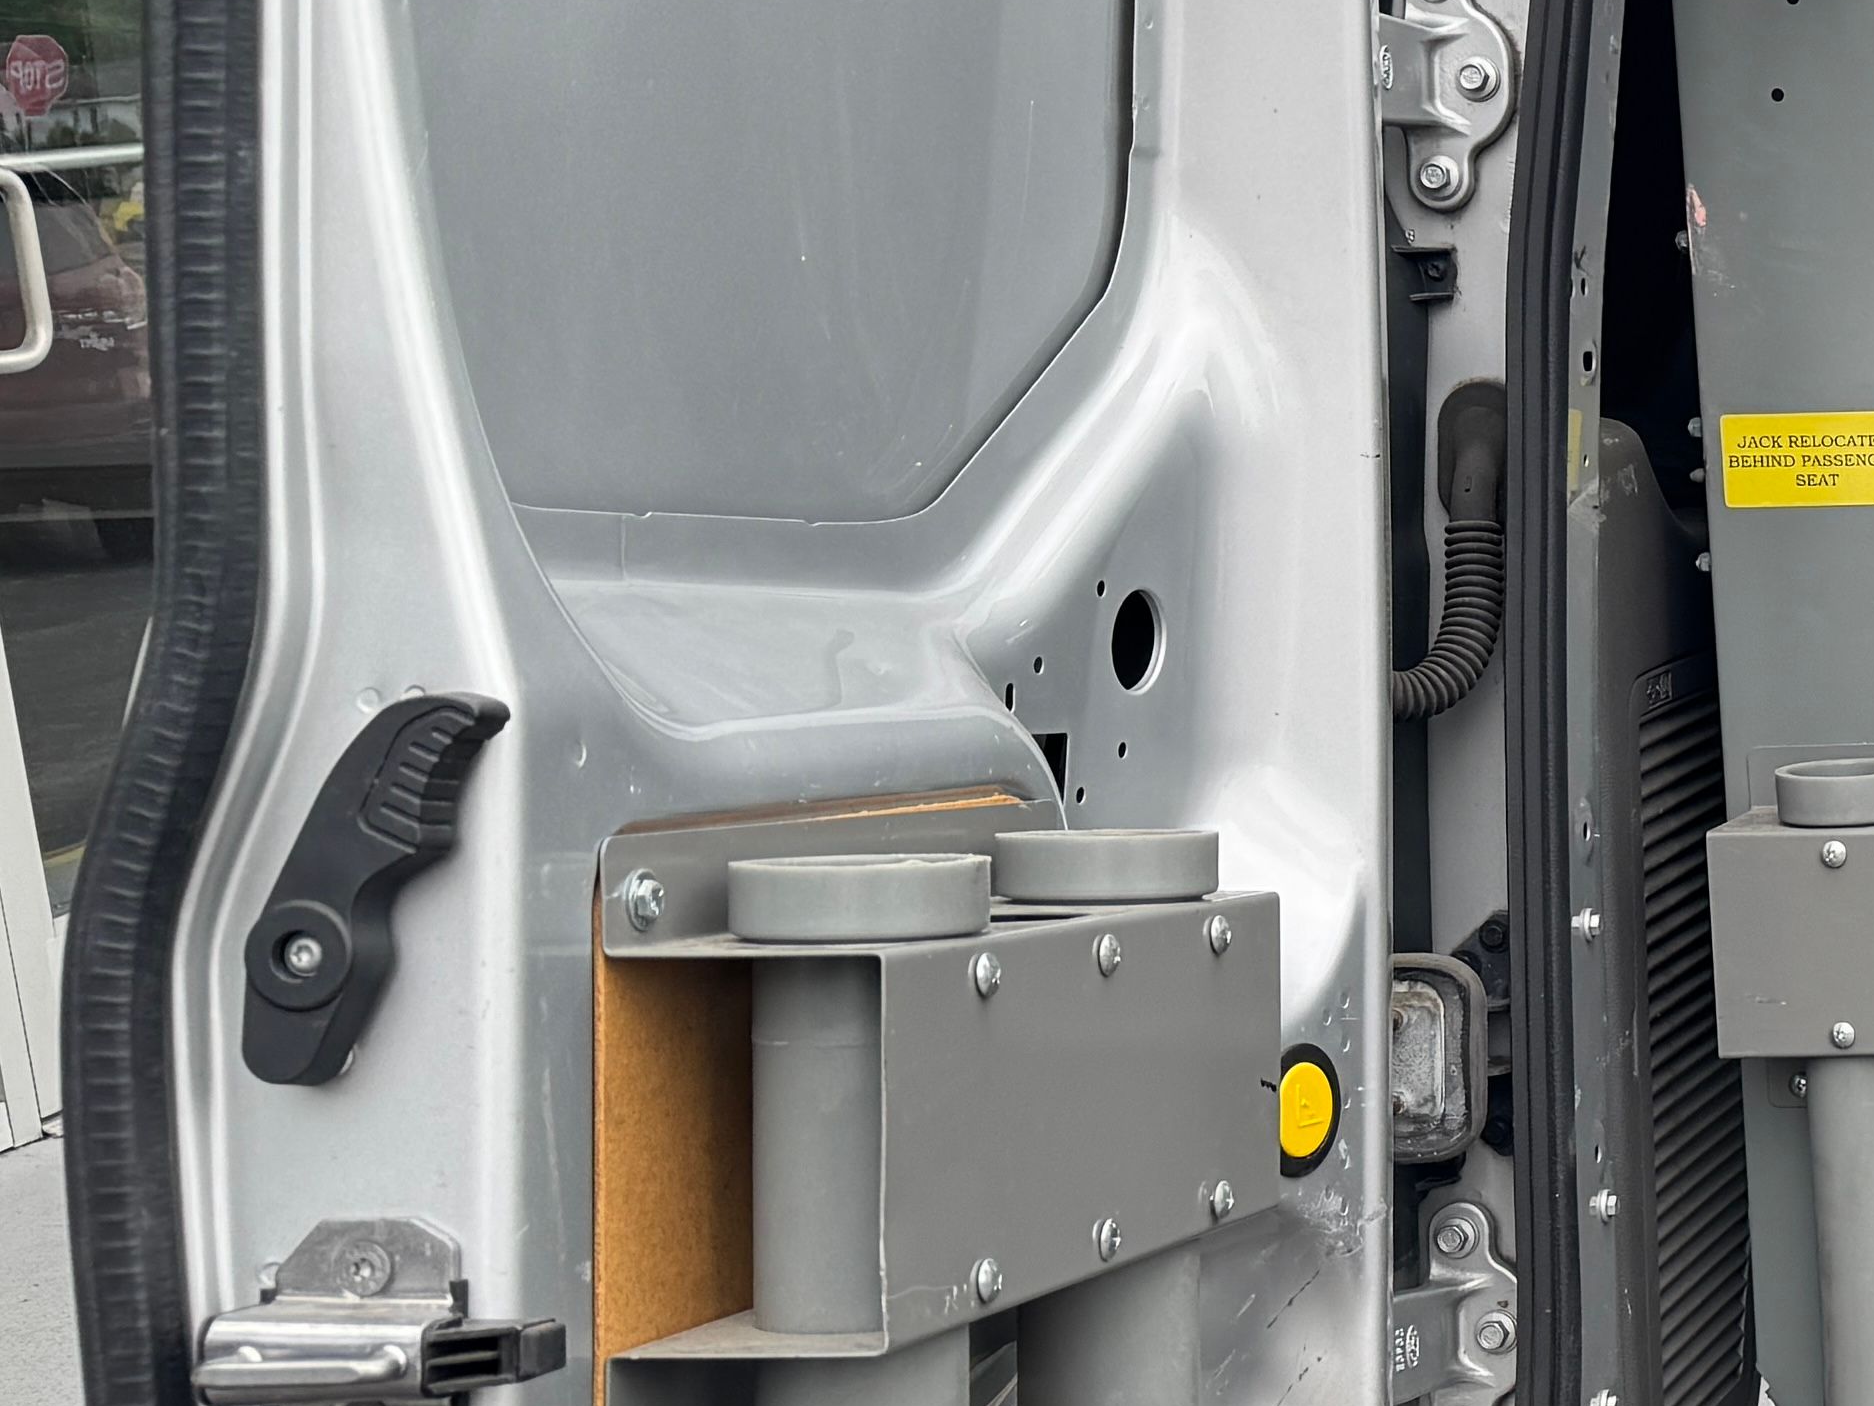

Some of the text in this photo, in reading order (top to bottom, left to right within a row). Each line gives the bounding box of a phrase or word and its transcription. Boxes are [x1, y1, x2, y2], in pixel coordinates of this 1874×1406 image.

[1737, 435, 1783, 449] JACK
[1728, 455, 1796, 468] BEHIND
[1795, 473, 1840, 487] SEAT
